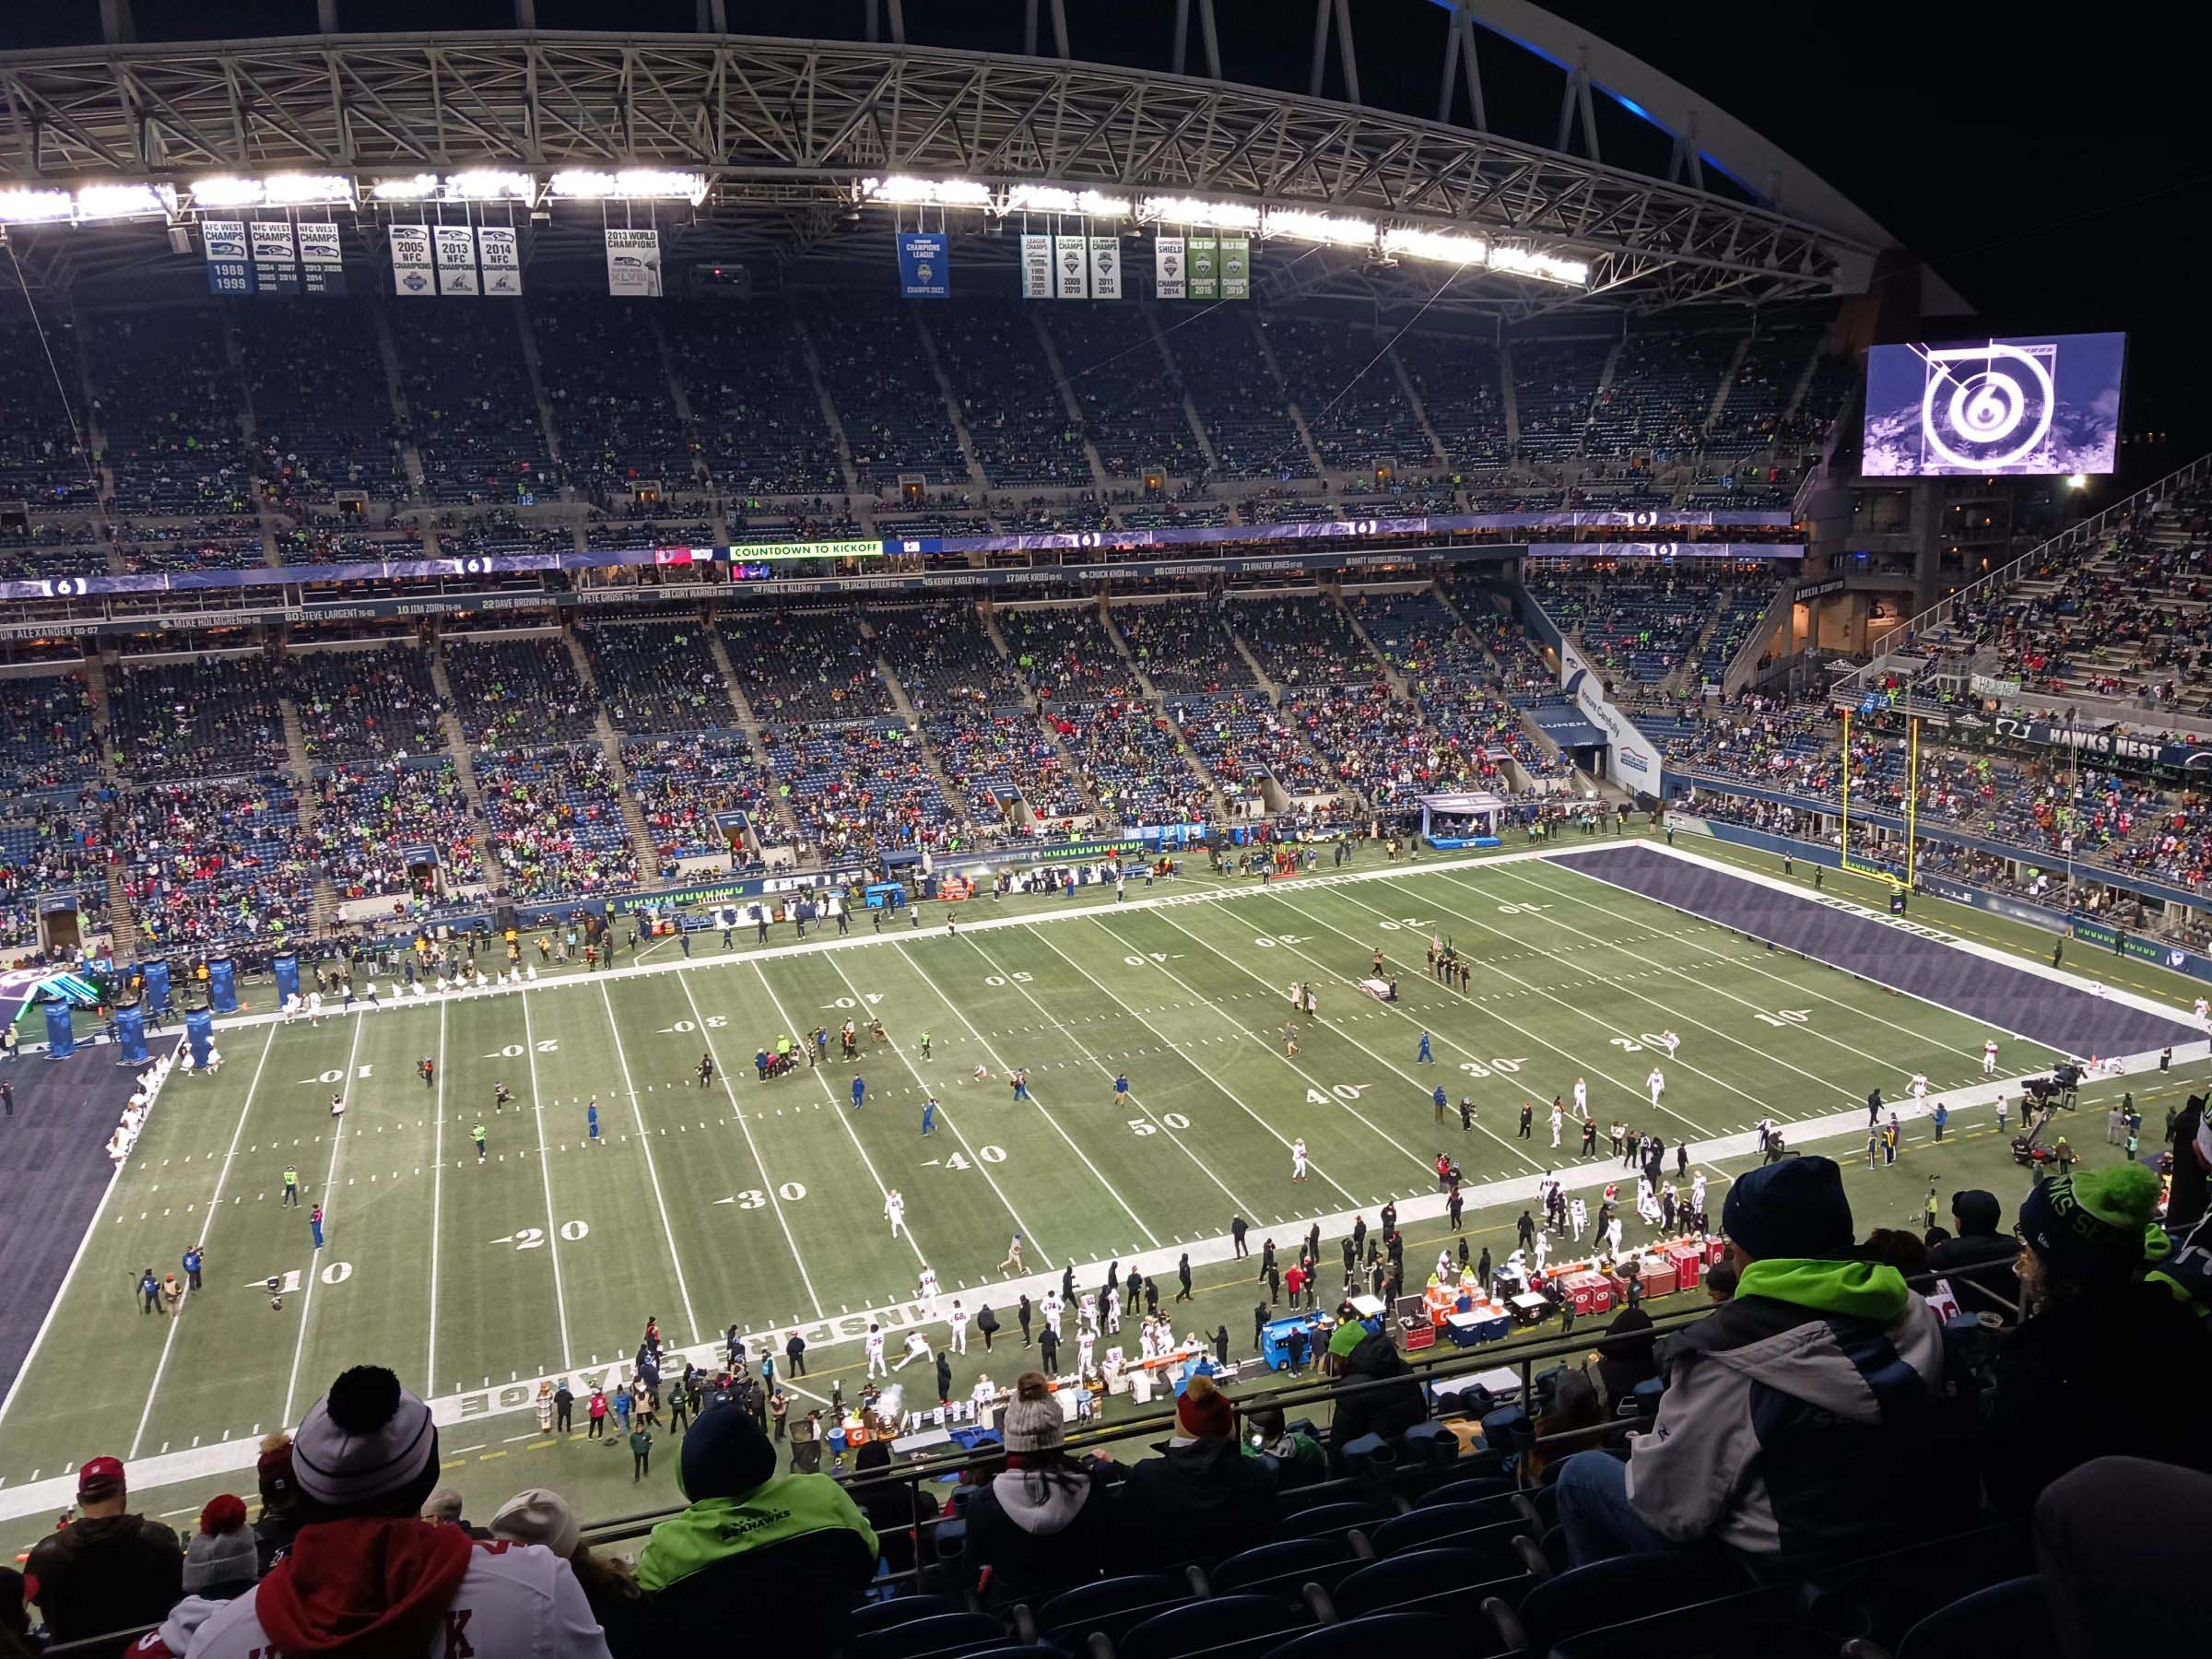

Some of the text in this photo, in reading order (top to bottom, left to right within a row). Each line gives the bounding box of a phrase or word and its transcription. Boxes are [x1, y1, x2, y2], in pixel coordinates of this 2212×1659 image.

[204, 223, 218, 231] AFC
[252, 224, 290, 232] NFC WEST
[206, 231, 244, 242] CHAMPS
[253, 232, 292, 243] CHAMPS
[300, 233, 338, 244] CHAMPS
[607, 231, 655, 241] 2013 WORLD
[397, 241, 424, 253] 2005
[441, 243, 468, 254] 2013
[485, 244, 512, 255] 2014
[607, 240, 656, 250] CHAMPIONS
[906, 243, 940, 252] CHAMPIONS
[1158, 245, 1182, 253] SHIELD
[403, 253, 421, 262] NFC
[447, 254, 465, 264] NFC
[490, 255, 509, 265] NFC
[912, 251, 935, 259] LEAGUE
[214, 265, 244, 276] 1988
[394, 262, 432, 270] CHAMPIONS
[482, 264, 519, 272] CHAMPIONS
[216, 278, 246, 290] 1999
[1064, 277, 1081, 286] 2009
[1098, 277, 1113, 286] 2011
[1157, 279, 1185, 288] CHAMPS
[1190, 278, 1217, 288] CHAMPS
[1221, 278, 1248, 288] CHAMPS
[1065, 286, 1081, 294] 2010
[1099, 286, 1114, 294] 2014
[523, 495, 534, 506] 12
[1637, 512, 1647, 524] 6
[1359, 521, 1367, 533] 6
[1081, 534, 1092, 546] 6
[735, 543, 878, 558] COUNTDOWN TO KICKOFF
[1659, 544, 1668, 555] 6
[467, 559, 480, 573] 6
[1186, 564, 1213, 575] KENNEDY
[1251, 561, 1273, 571] WALTER
[1273, 560, 1291, 571] JONES
[923, 575, 976, 587] 45 KENNY EASLEY
[1006, 571, 1050, 583] 17 DAVE KRIEG
[57, 579, 73, 595] 6
[763, 584, 777, 594] PAUL
[785, 582, 806, 594] ALLEN
[839, 580, 891, 591] 79 JACOB GREEN
[582, 593, 624, 604] PETE GROSS
[659, 587, 718, 599] 28 CURT WARNER
[482, 596, 540, 610] 22 DAVE BROWN
[285, 608, 358, 622] 80 STEVE LARGENT
[397, 603, 445, 616] 10 JIM ZORN
[173, 615, 243, 629] MIKE HOLMGREN
[17, 627, 73, 641] ALEXANDER
[74, 626, 99, 636] 00-07
[1877, 696, 1888, 708] 12
[1538, 721, 1588, 729] LUMEN
[2049, 727, 2163, 761] HAWKS NEST
[1815, 896, 1961, 945] END RACISM
[1126, 1112, 1192, 1137] 50
[944, 1144, 1008, 1171] 40
[736, 1181, 807, 1210] 30
[515, 1219, 590, 1252] 20
[713, 1304, 926, 1359] INSPRE
[851, 1429, 864, 1441] G
